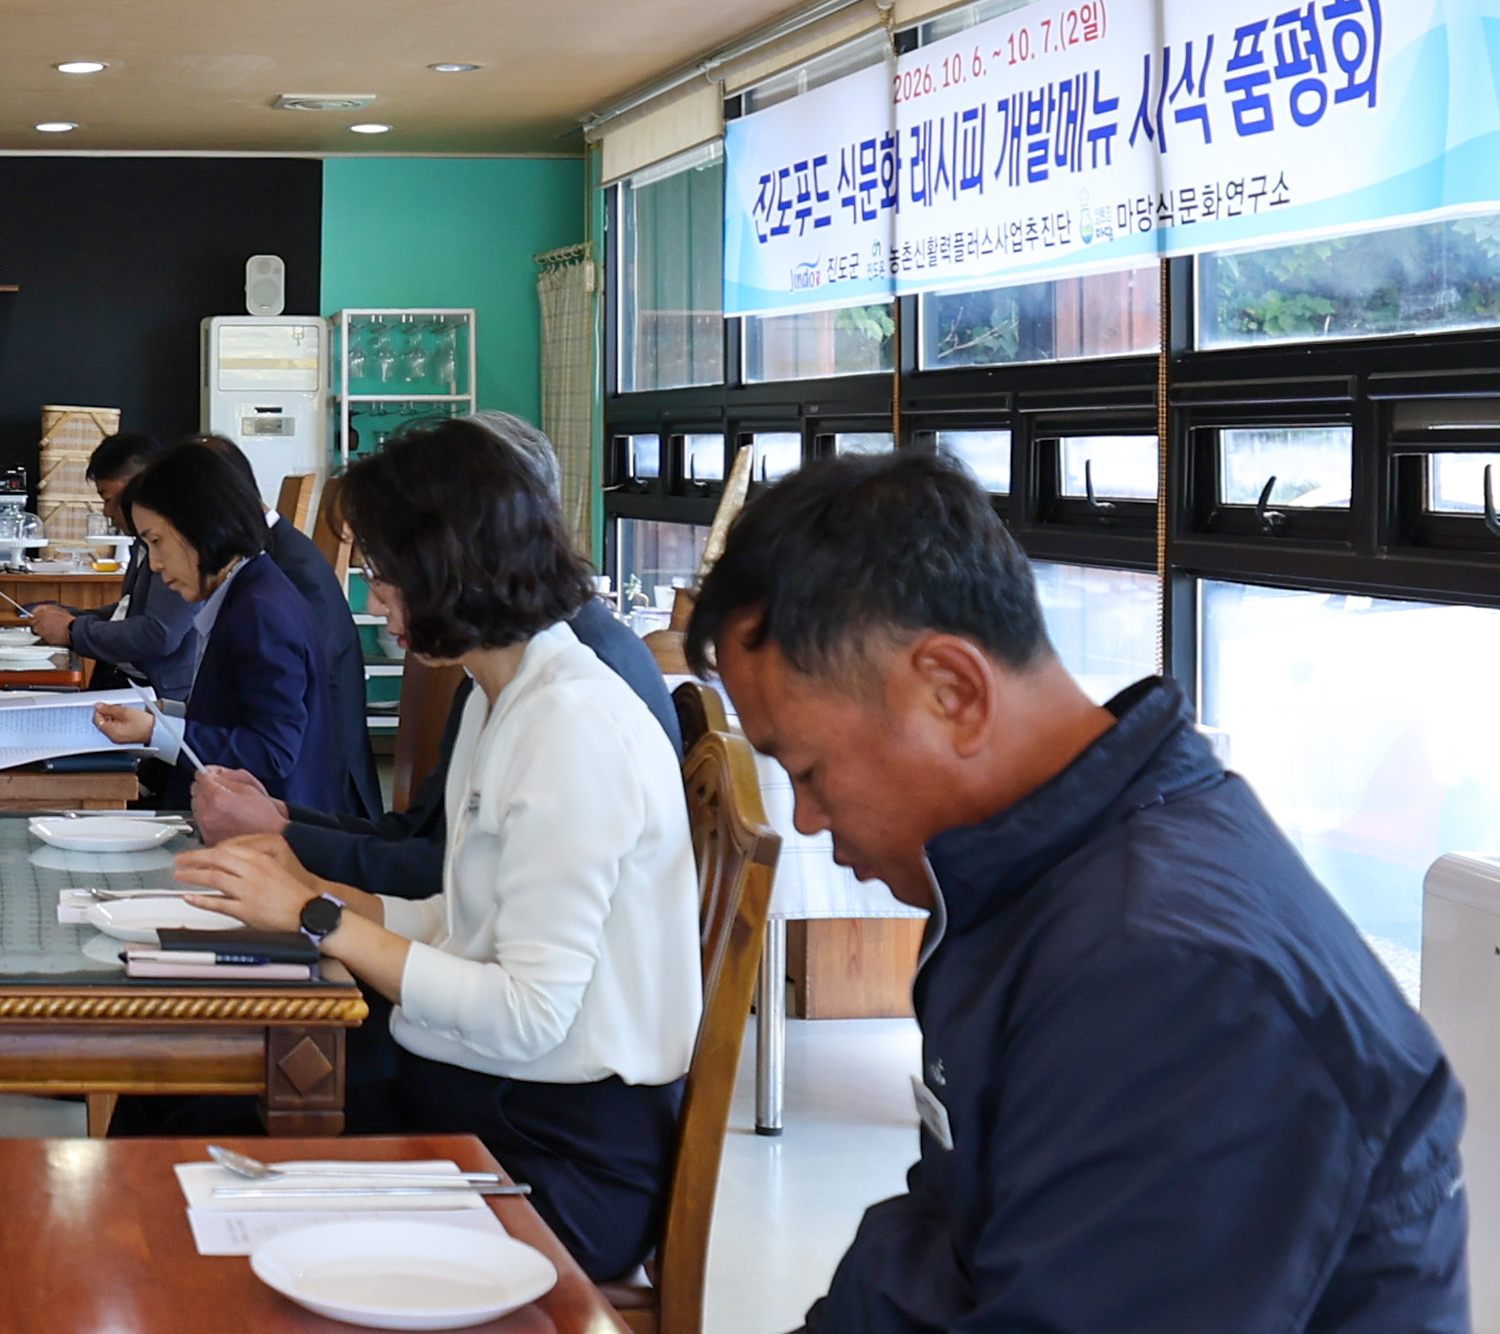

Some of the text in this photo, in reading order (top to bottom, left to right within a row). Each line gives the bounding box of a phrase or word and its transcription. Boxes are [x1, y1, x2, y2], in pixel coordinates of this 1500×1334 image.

[893, 63, 937, 104] 2026.
[943, 53, 967, 87] 10.
[972, 45, 987, 77] 6.
[1007, 28, 1035, 65] 10.
[752, 154, 832, 244] 진도푸드
[837, 130, 902, 224] 식문화
[910, 103, 987, 207] 레시피
[994, 69, 1120, 187] 개발메뉴
[1128, 33, 1214, 154] 시식
[1117, 171, 1290, 235] 마당식문화연구소
[827, 253, 860, 283] 진도군
[889, 210, 1071, 274] 농촌신활력플러스사업추진단
